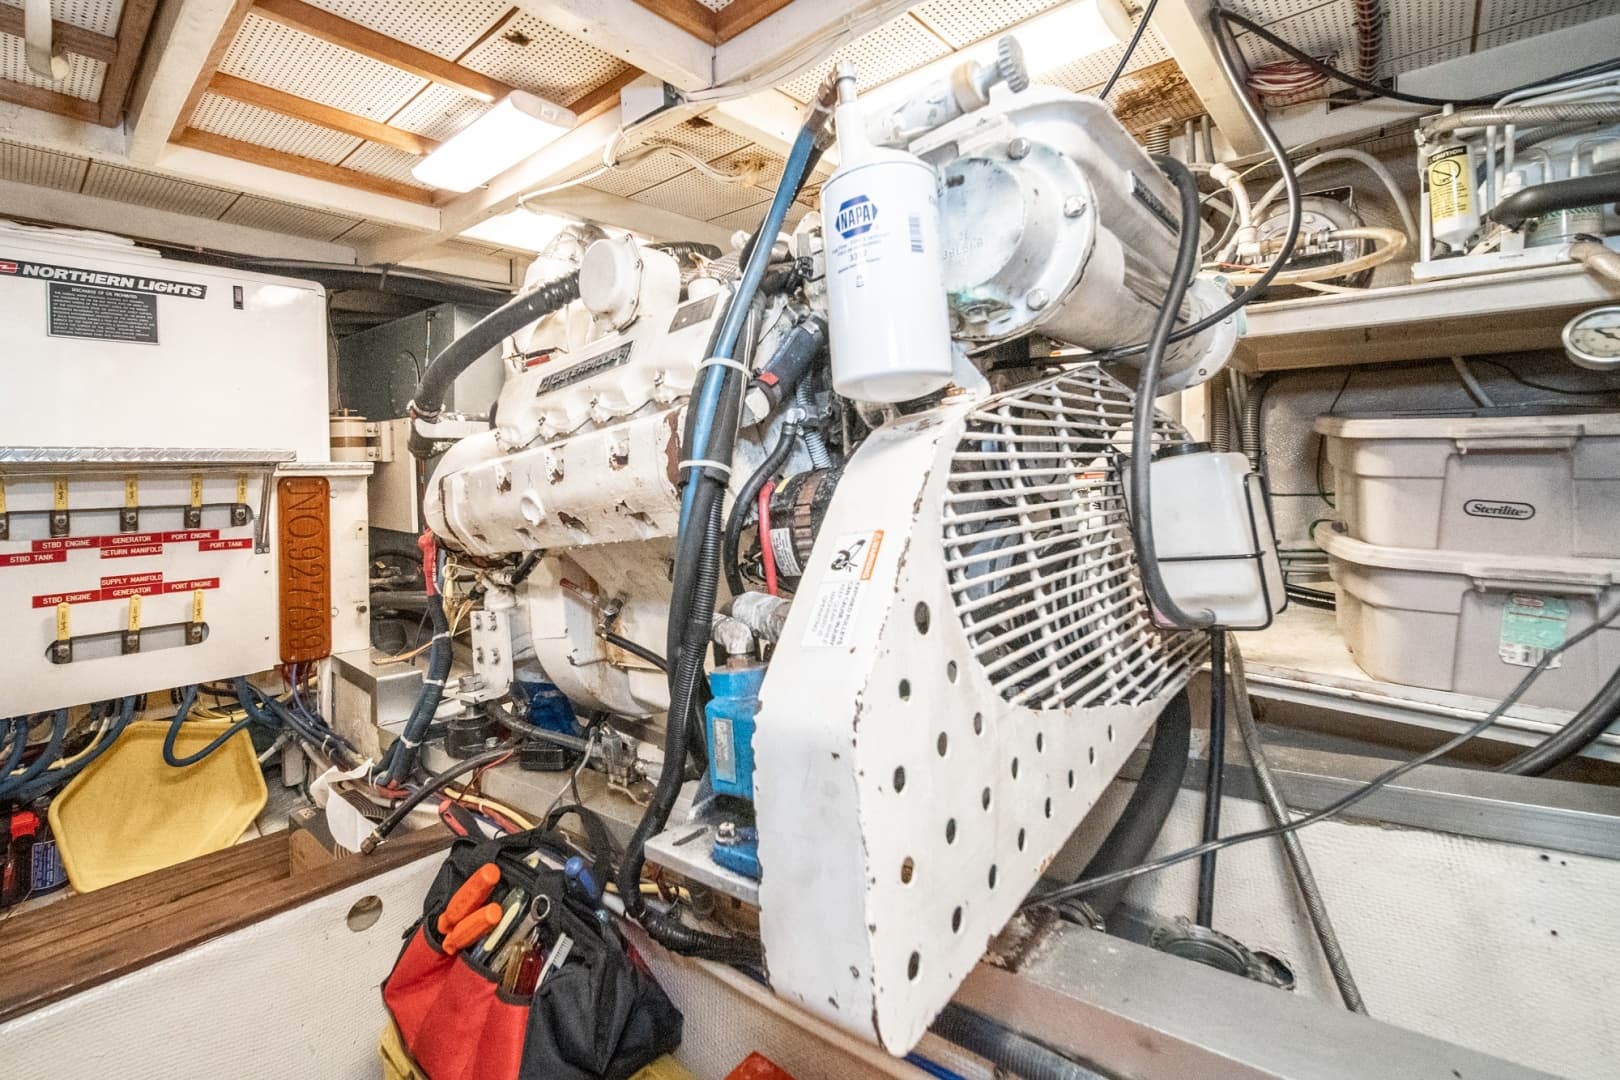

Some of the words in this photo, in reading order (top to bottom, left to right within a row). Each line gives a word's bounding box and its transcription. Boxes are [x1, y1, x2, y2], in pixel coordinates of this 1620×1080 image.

[840, 204, 871, 231] NAPA
[22, 264, 134, 289] NORTHERN
[138, 279, 203, 297] LIGHTS
[1471, 503, 1521, 516] Sterilite
[112, 535, 151, 545] GENERATOR
[171, 533, 187, 541] PORT
[190, 531, 212, 540] ENGINE
[42, 541, 62, 550] STBD
[65, 539, 91, 547] ENGINE
[227, 540, 243, 548] TANK
[101, 548, 128, 557] RETURN
[130, 545, 163, 554] MANIFOLD
[10, 555, 30, 563] STBD
[35, 553, 54, 561] TANK
[101, 577, 127, 586] SUPPLY
[130, 574, 163, 583] MANIFOLD
[171, 582, 187, 590] PORT
[190, 580, 212, 589] ENGINE
[112, 586, 151, 597] GENERATOR
[43, 597, 62, 605] STBD
[66, 594, 92, 602] ENGINE
